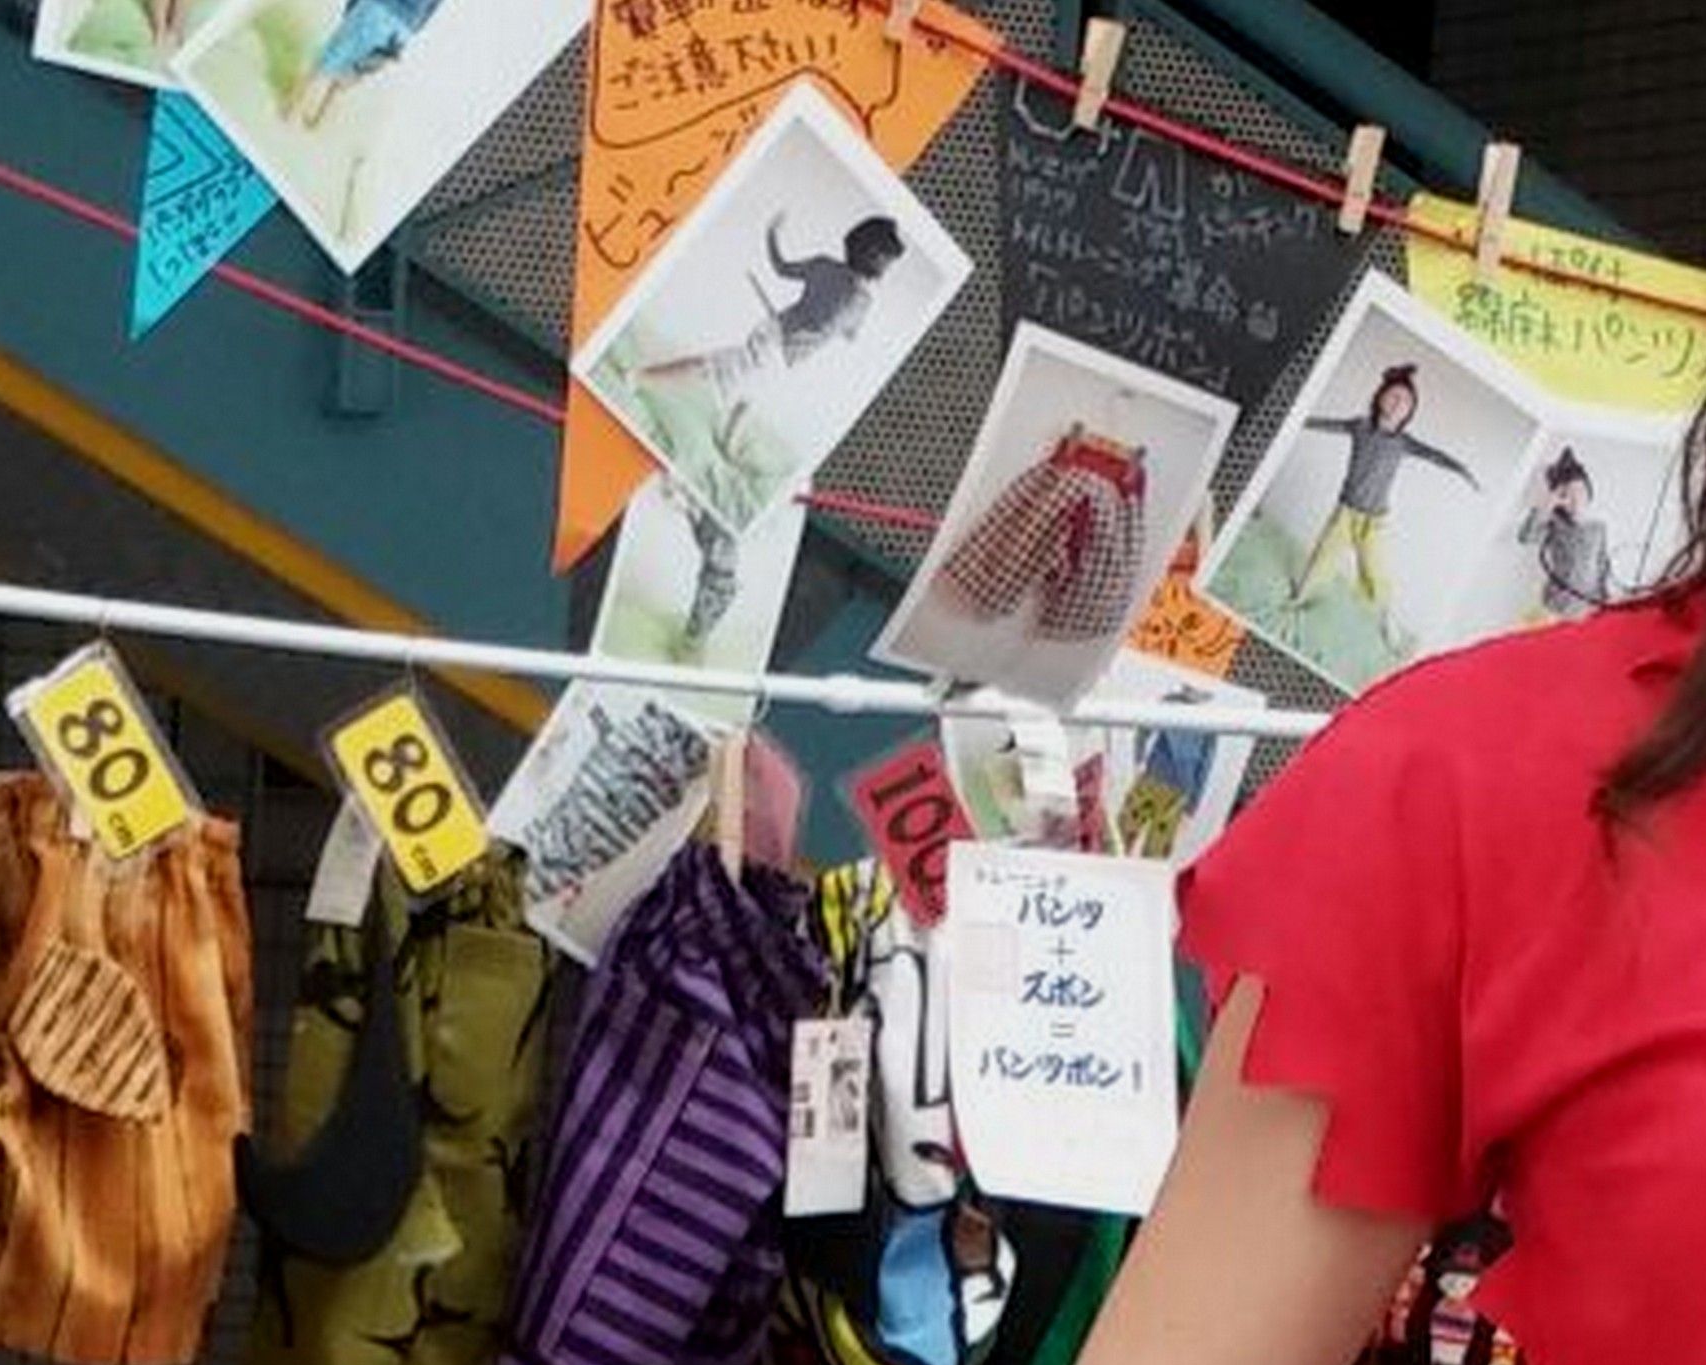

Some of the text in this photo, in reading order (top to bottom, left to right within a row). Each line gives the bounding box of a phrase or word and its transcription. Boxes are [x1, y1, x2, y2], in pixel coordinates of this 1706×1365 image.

[58, 699, 149, 801] 80
[363, 733, 451, 835] 80
[1018, 892, 1103, 930] パンツ
